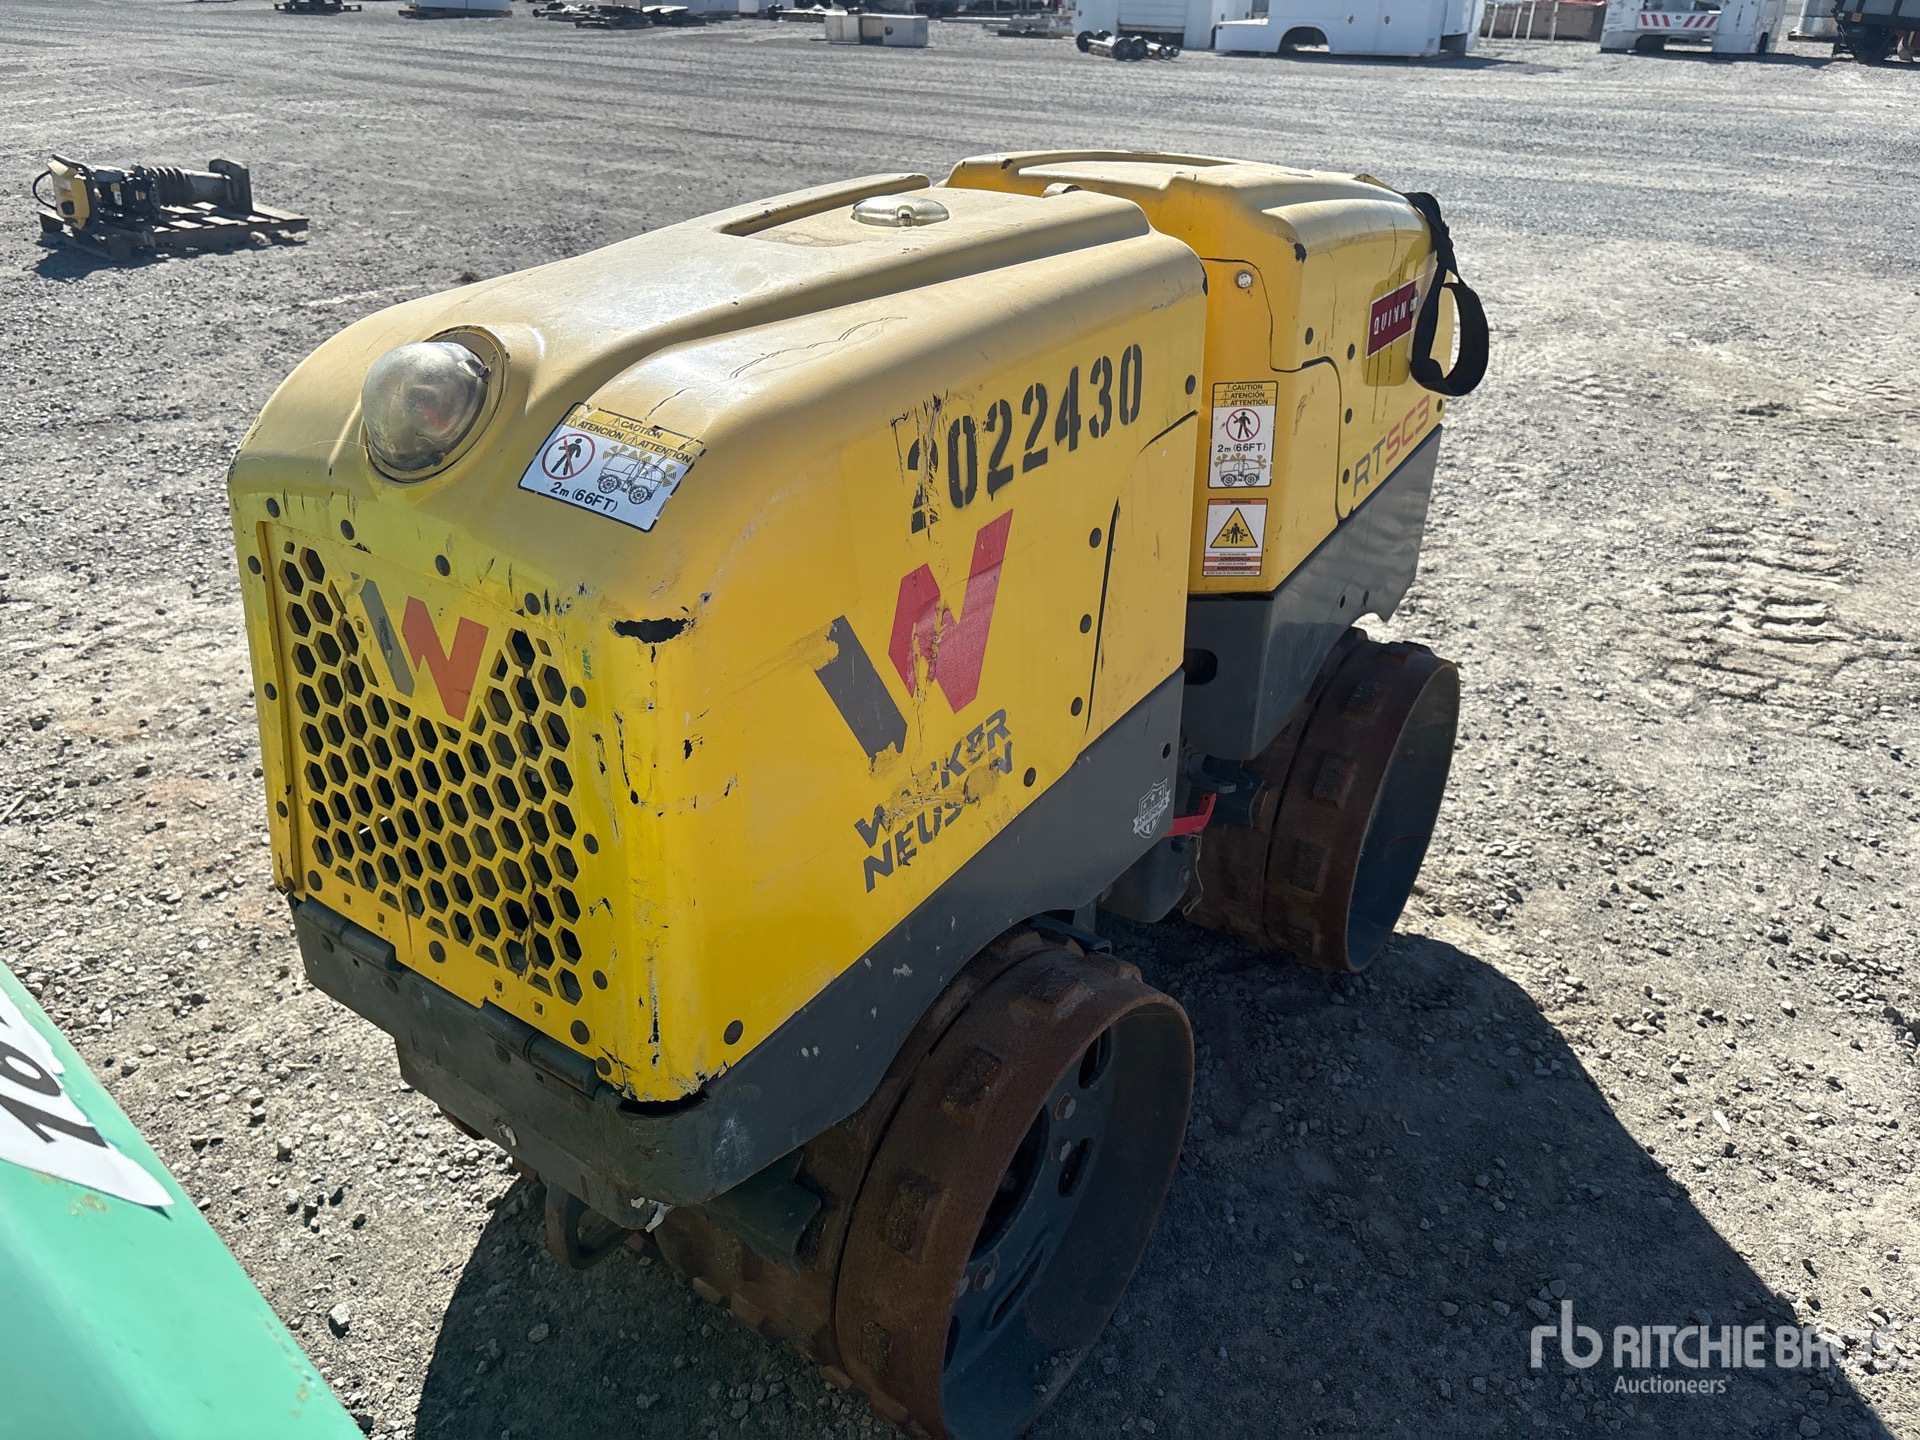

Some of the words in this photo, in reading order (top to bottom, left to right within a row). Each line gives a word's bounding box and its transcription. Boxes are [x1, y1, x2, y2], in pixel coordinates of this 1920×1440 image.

[1373, 301, 1407, 335] QUINN
[620, 420, 664, 440] CAUTION
[638, 439, 693, 464] ATTENTION
[1353, 394, 1430, 497] RTSC3
